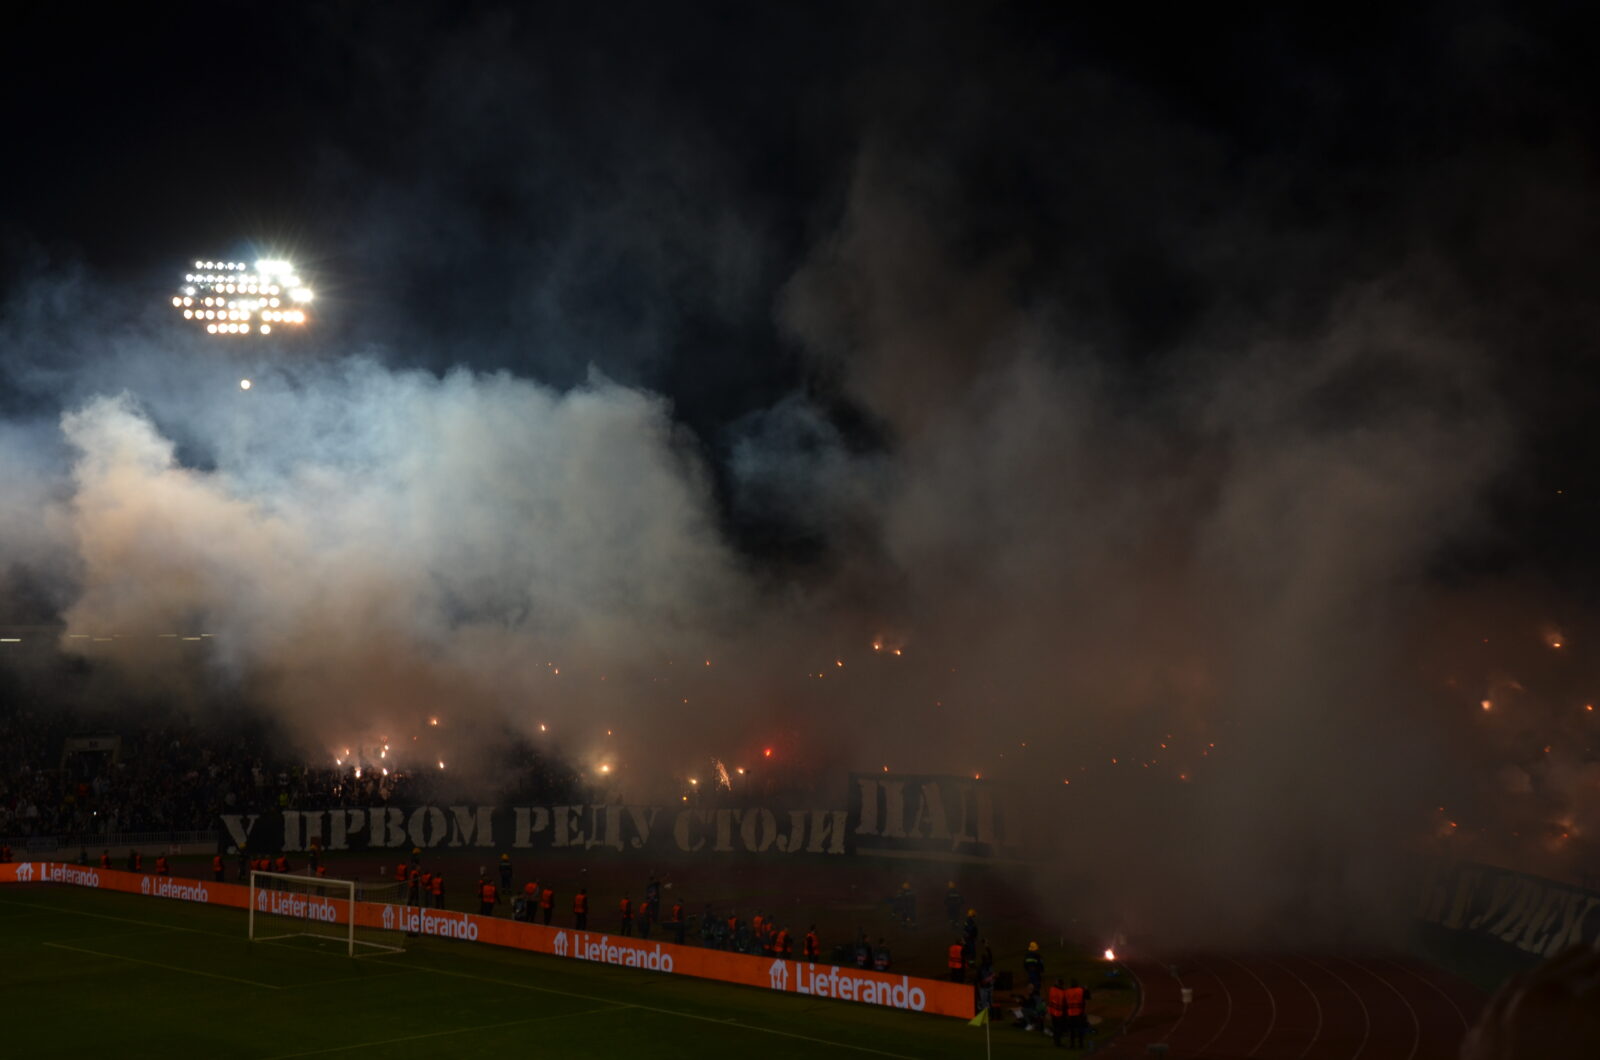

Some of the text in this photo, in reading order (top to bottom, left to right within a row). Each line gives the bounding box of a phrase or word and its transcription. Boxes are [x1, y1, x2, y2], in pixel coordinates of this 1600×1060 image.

[220, 814, 261, 855] У
[281, 807, 496, 852] ПРВОМ
[512, 805, 662, 852] РЕДУ
[673, 807, 849, 855] СТОЈИ
[41, 863, 99, 887] Lieferando
[152, 879, 208, 904] Lieferando
[271, 891, 337, 922] Lieferando
[399, 906, 478, 941] Lieferando
[574, 933, 673, 973] Lieferando
[796, 962, 927, 1012] Lieferando
